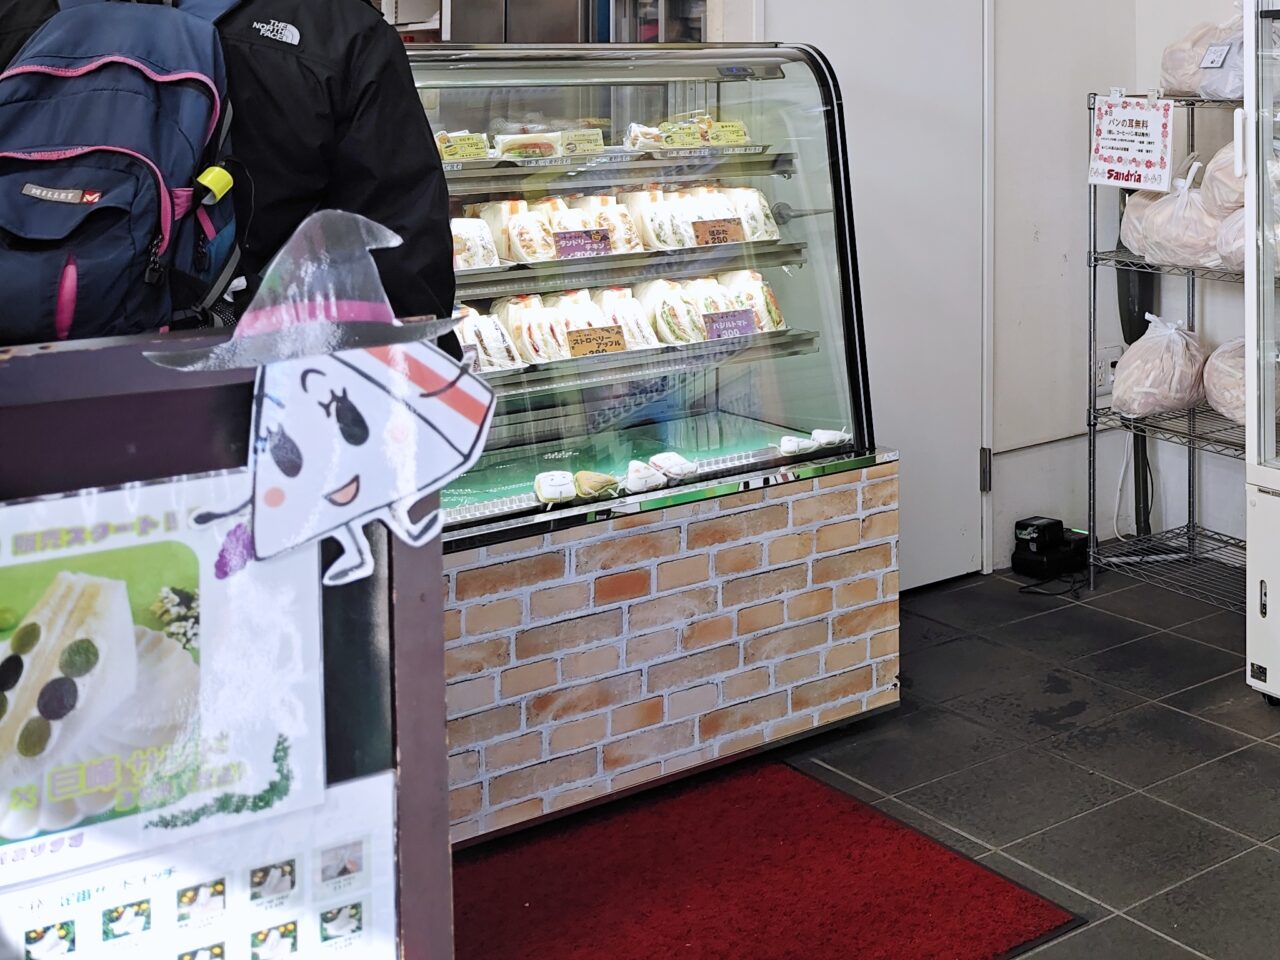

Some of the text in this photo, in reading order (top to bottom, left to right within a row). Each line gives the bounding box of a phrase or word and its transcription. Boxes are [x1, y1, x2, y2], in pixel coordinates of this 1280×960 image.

[253, 22, 285, 35] NORTH
[270, 20, 287, 29] THE
[260, 29, 284, 41] FACE
[1108, 119, 1148, 129] パンの耳無料
[1107, 169, 1142, 182] Sandria
[31, 188, 74, 199] MILLET
[713, 321, 747, 329] バジルトマト
